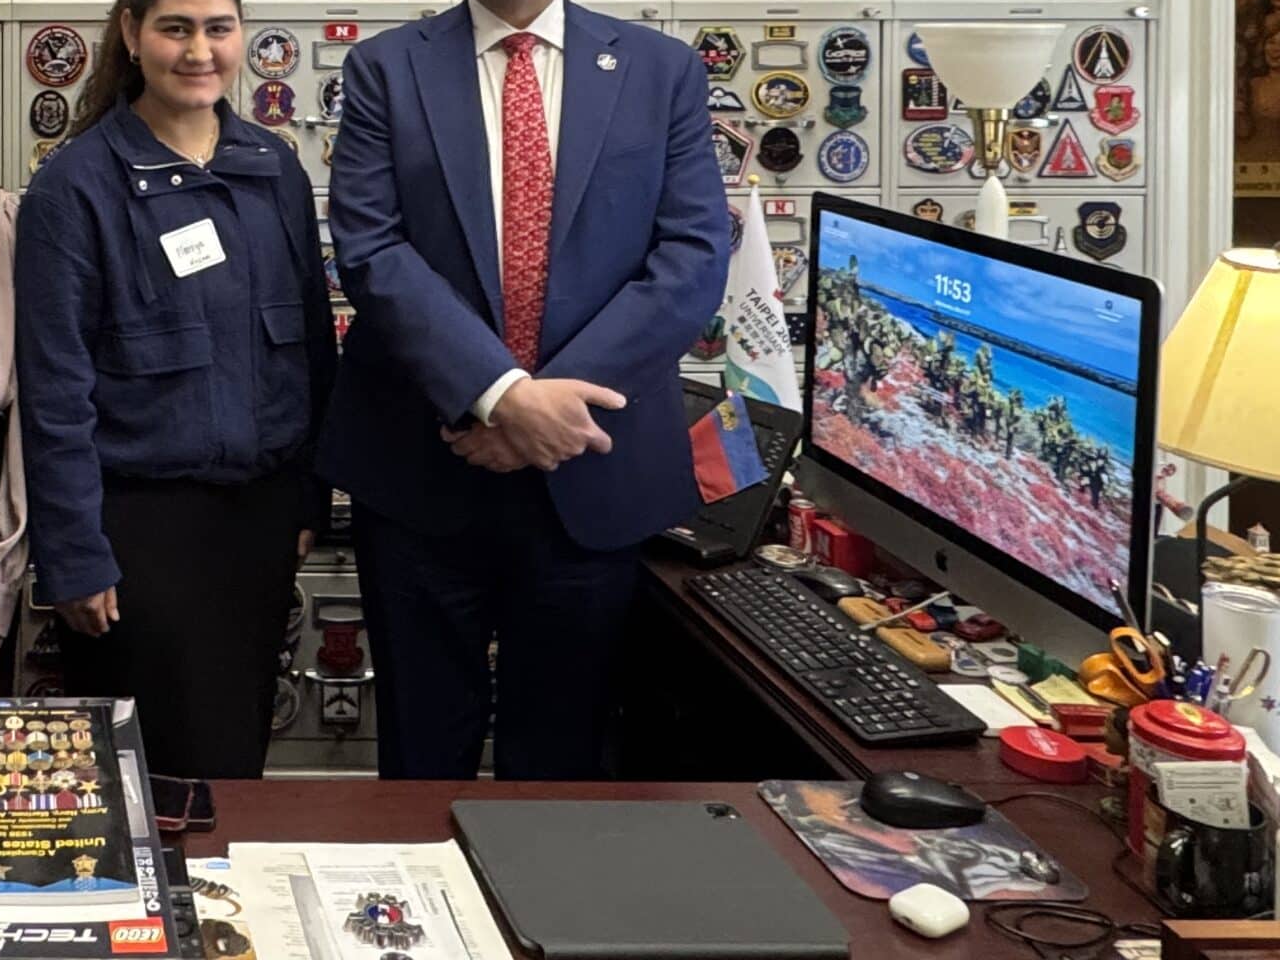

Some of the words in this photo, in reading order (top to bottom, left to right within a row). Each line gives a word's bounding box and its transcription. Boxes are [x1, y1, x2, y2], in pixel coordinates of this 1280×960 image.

[335, 26, 350, 37] N
[935, 273, 972, 304] 11:53
[745, 287, 780, 328] TAIPEI
[3, 838, 53, 849] States
[56, 837, 106, 848] United
[111, 926, 162, 943] LEGO
